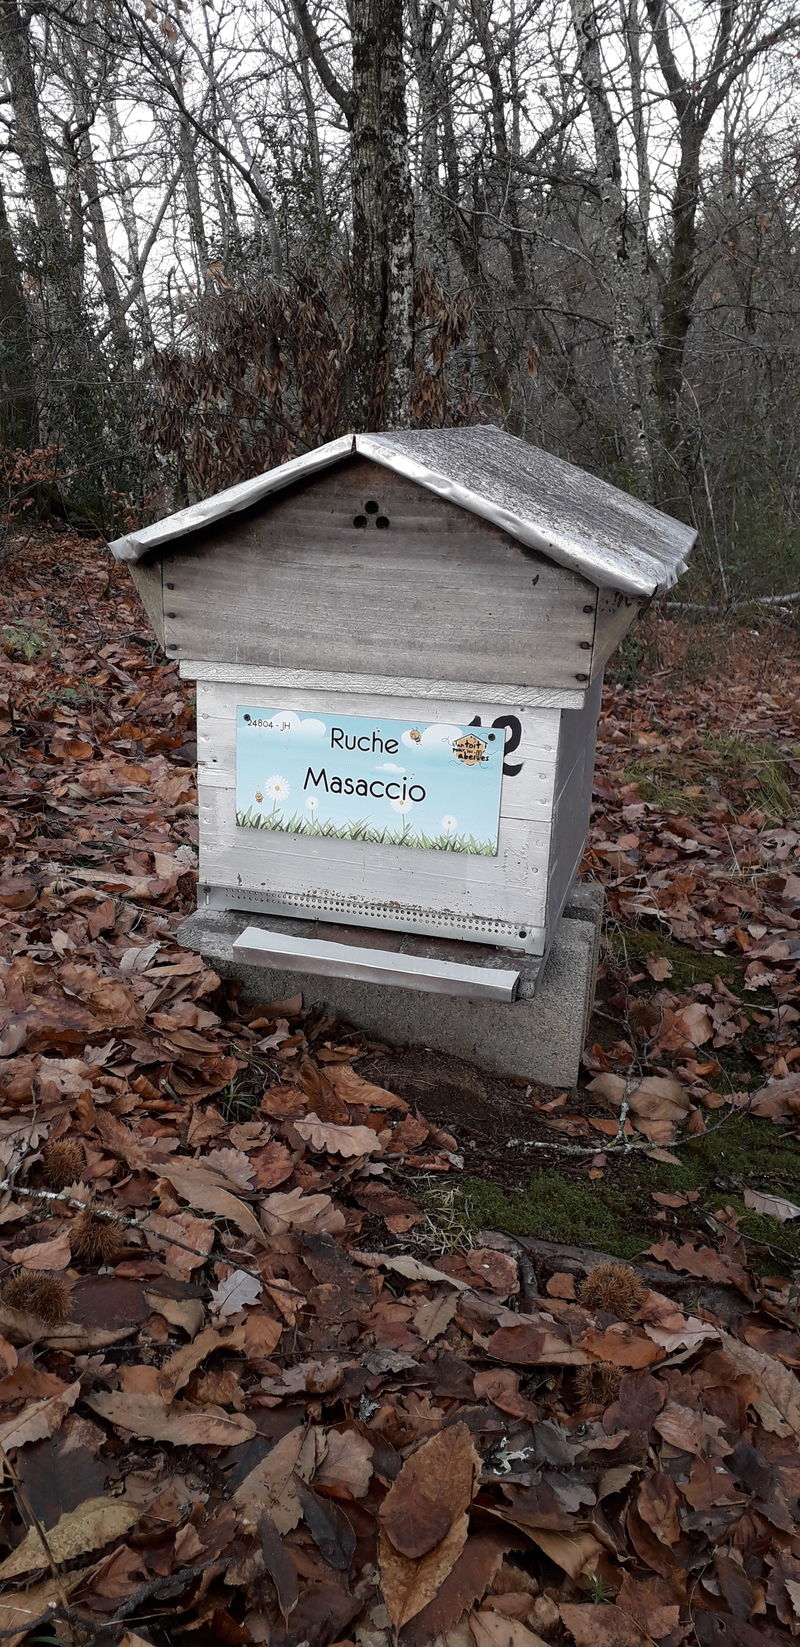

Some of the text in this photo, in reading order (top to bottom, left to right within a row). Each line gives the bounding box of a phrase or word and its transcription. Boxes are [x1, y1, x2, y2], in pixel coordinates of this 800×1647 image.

[247, 718, 274, 729] 24804
[280, 721, 291, 732] JH
[330, 727, 400, 755] Ruche
[464, 739, 482, 749] toit
[457, 749, 490, 762] abeilles
[303, 766, 427, 803] Masaccio
